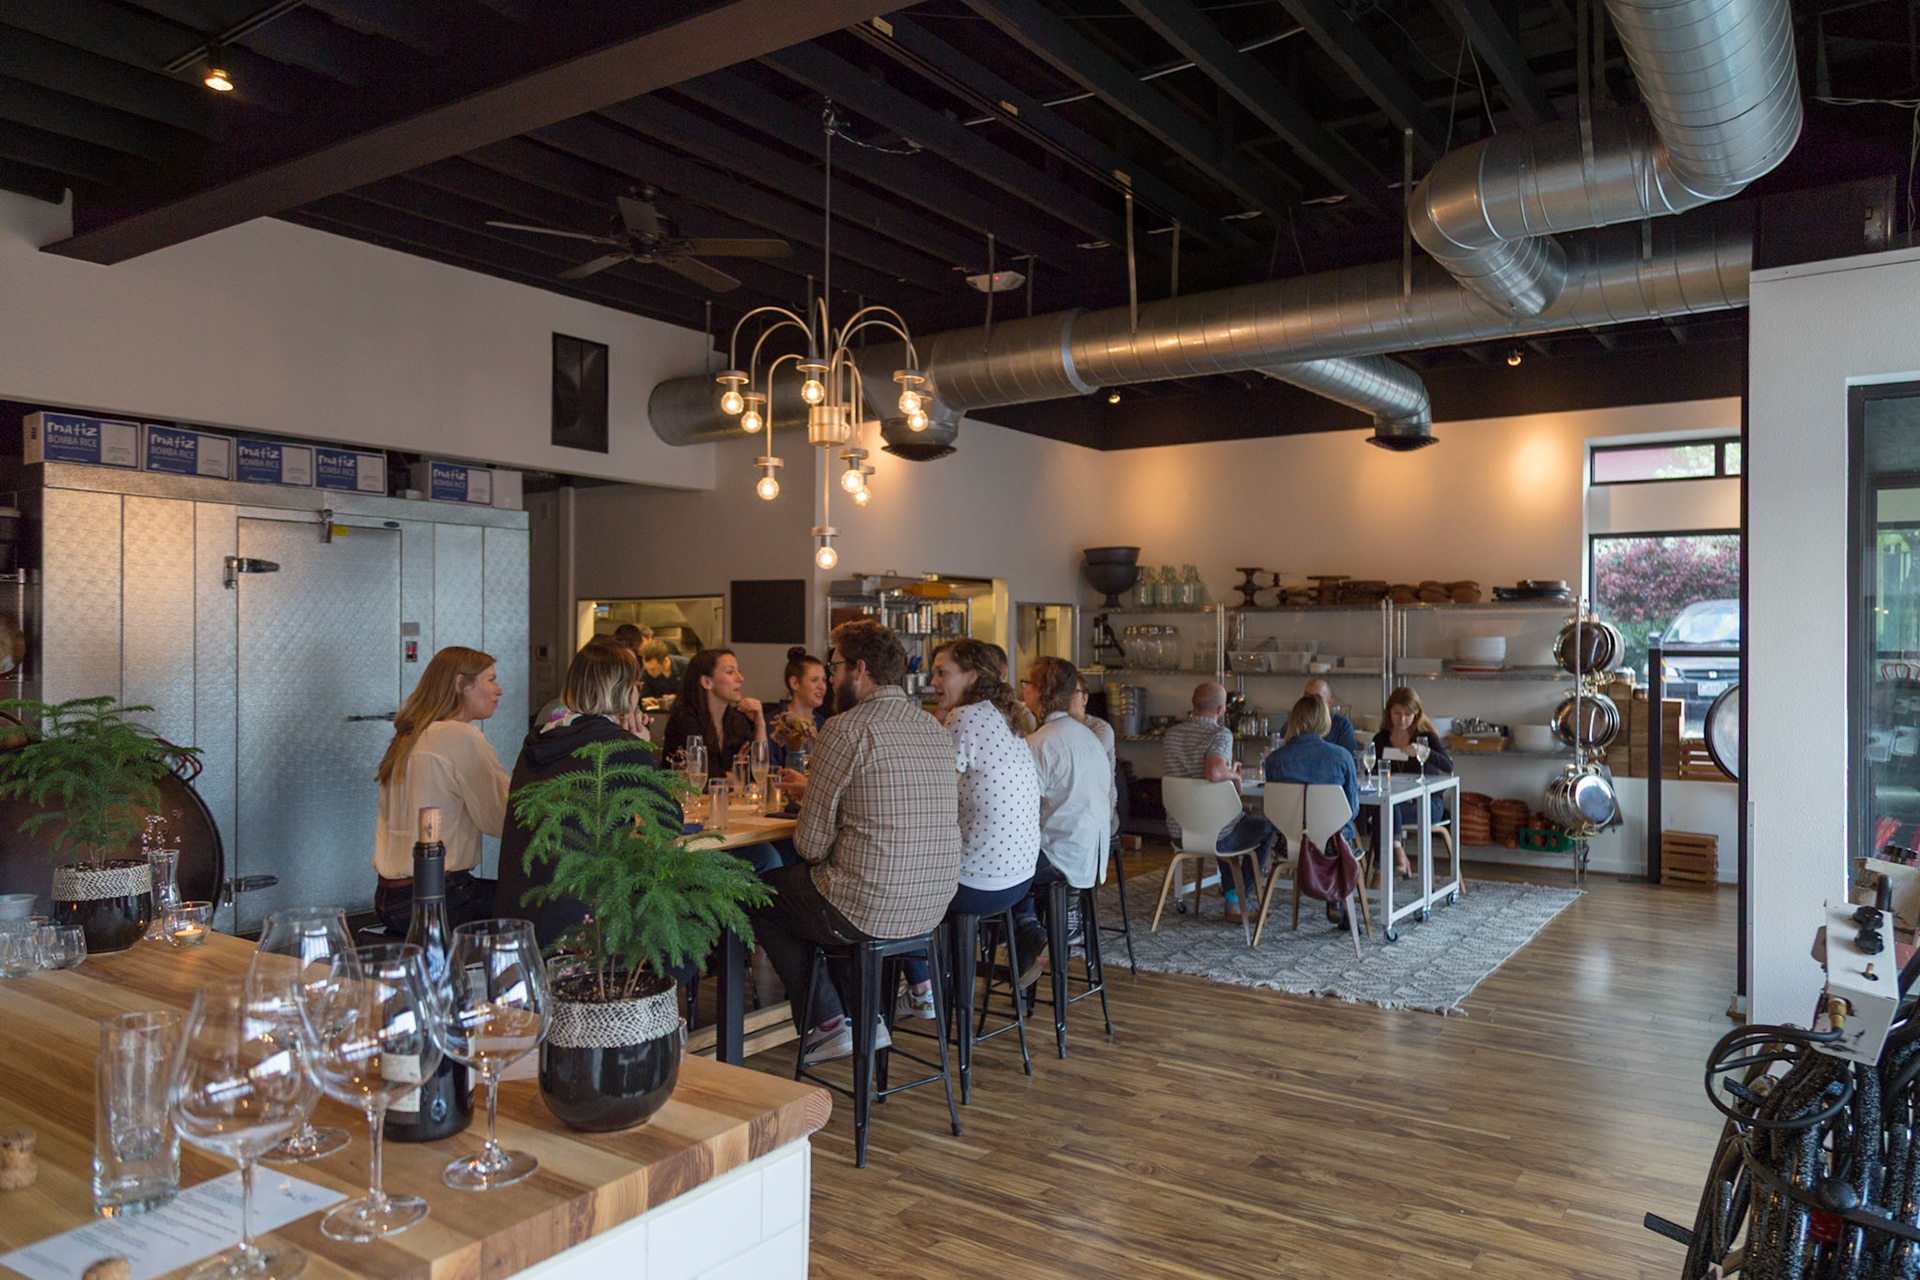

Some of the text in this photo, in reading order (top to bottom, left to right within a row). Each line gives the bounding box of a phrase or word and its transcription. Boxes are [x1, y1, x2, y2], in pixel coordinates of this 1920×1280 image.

[47, 421, 98, 436] matiz
[48, 434, 78, 445] BOMBA
[80, 437, 97, 448] RICE
[151, 434, 195, 448] matiz
[151, 446, 178, 457] BOMBA
[180, 449, 195, 459] RICE
[239, 445, 279, 459] matiz
[318, 454, 355, 468] matiz
